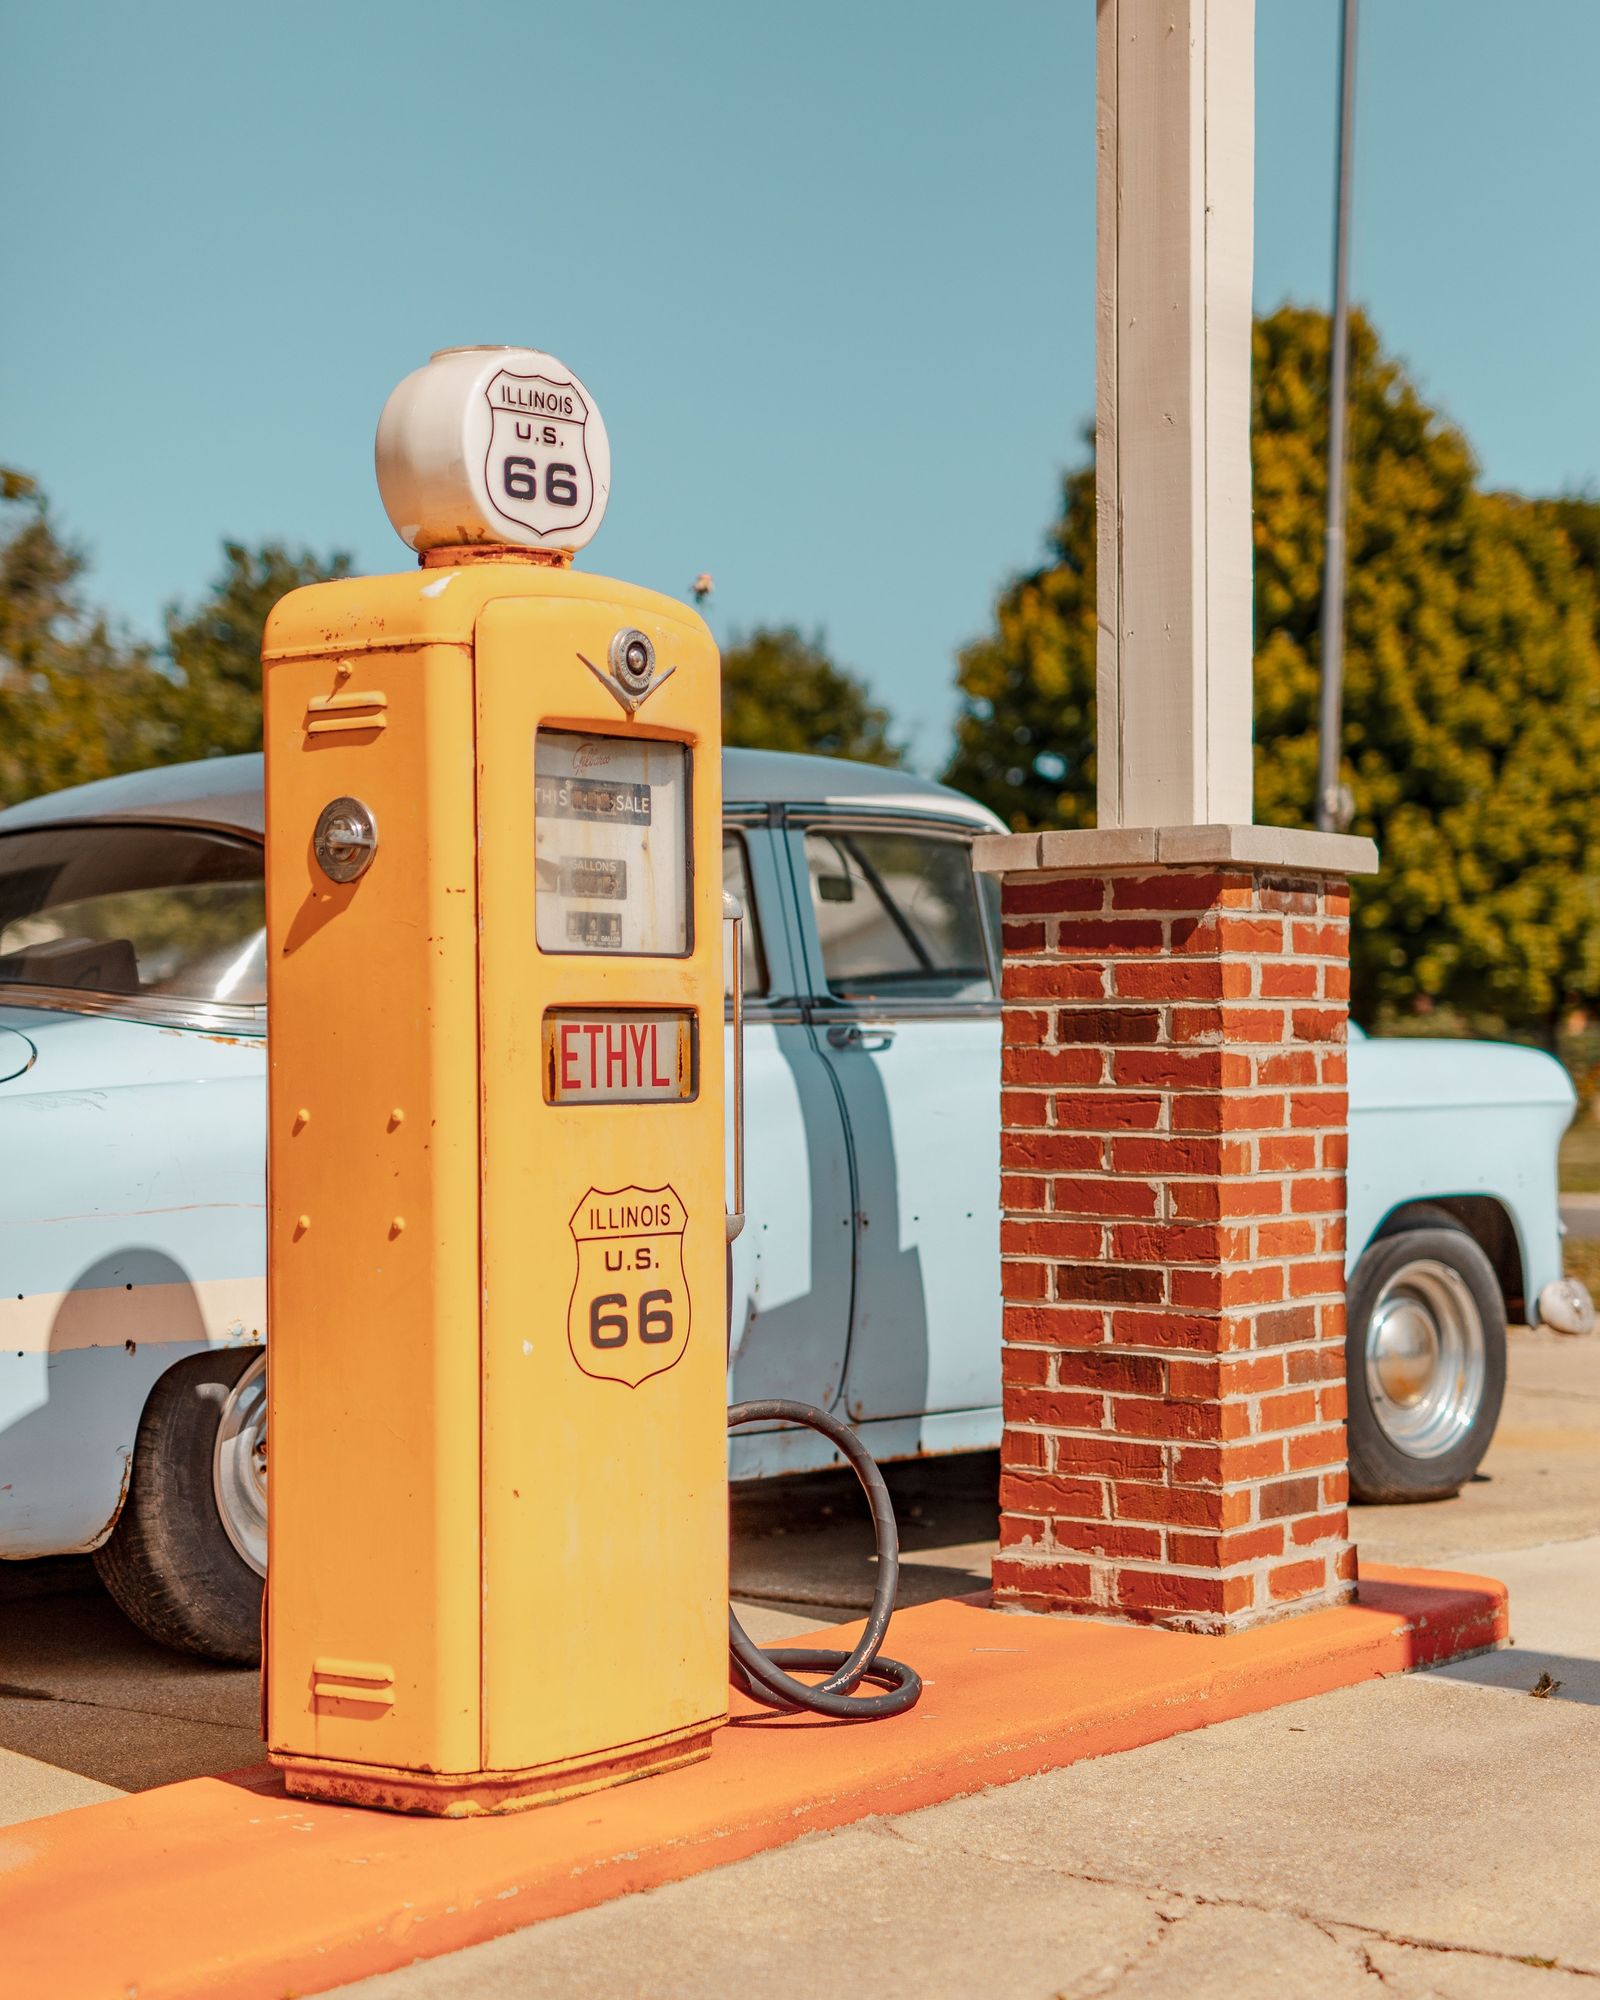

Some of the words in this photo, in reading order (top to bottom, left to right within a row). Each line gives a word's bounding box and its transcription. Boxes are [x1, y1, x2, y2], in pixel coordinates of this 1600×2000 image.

[502, 385, 573, 415] ILLINOIS
[516, 422, 564, 446] U.S.
[504, 456, 578, 507] 66
[616, 795, 650, 814] SALE
[561, 1024, 670, 1089] ETHYL
[590, 1203, 671, 1230] ILLINOIS
[605, 1247, 660, 1271] U.S.
[589, 1288, 674, 1349] 66
